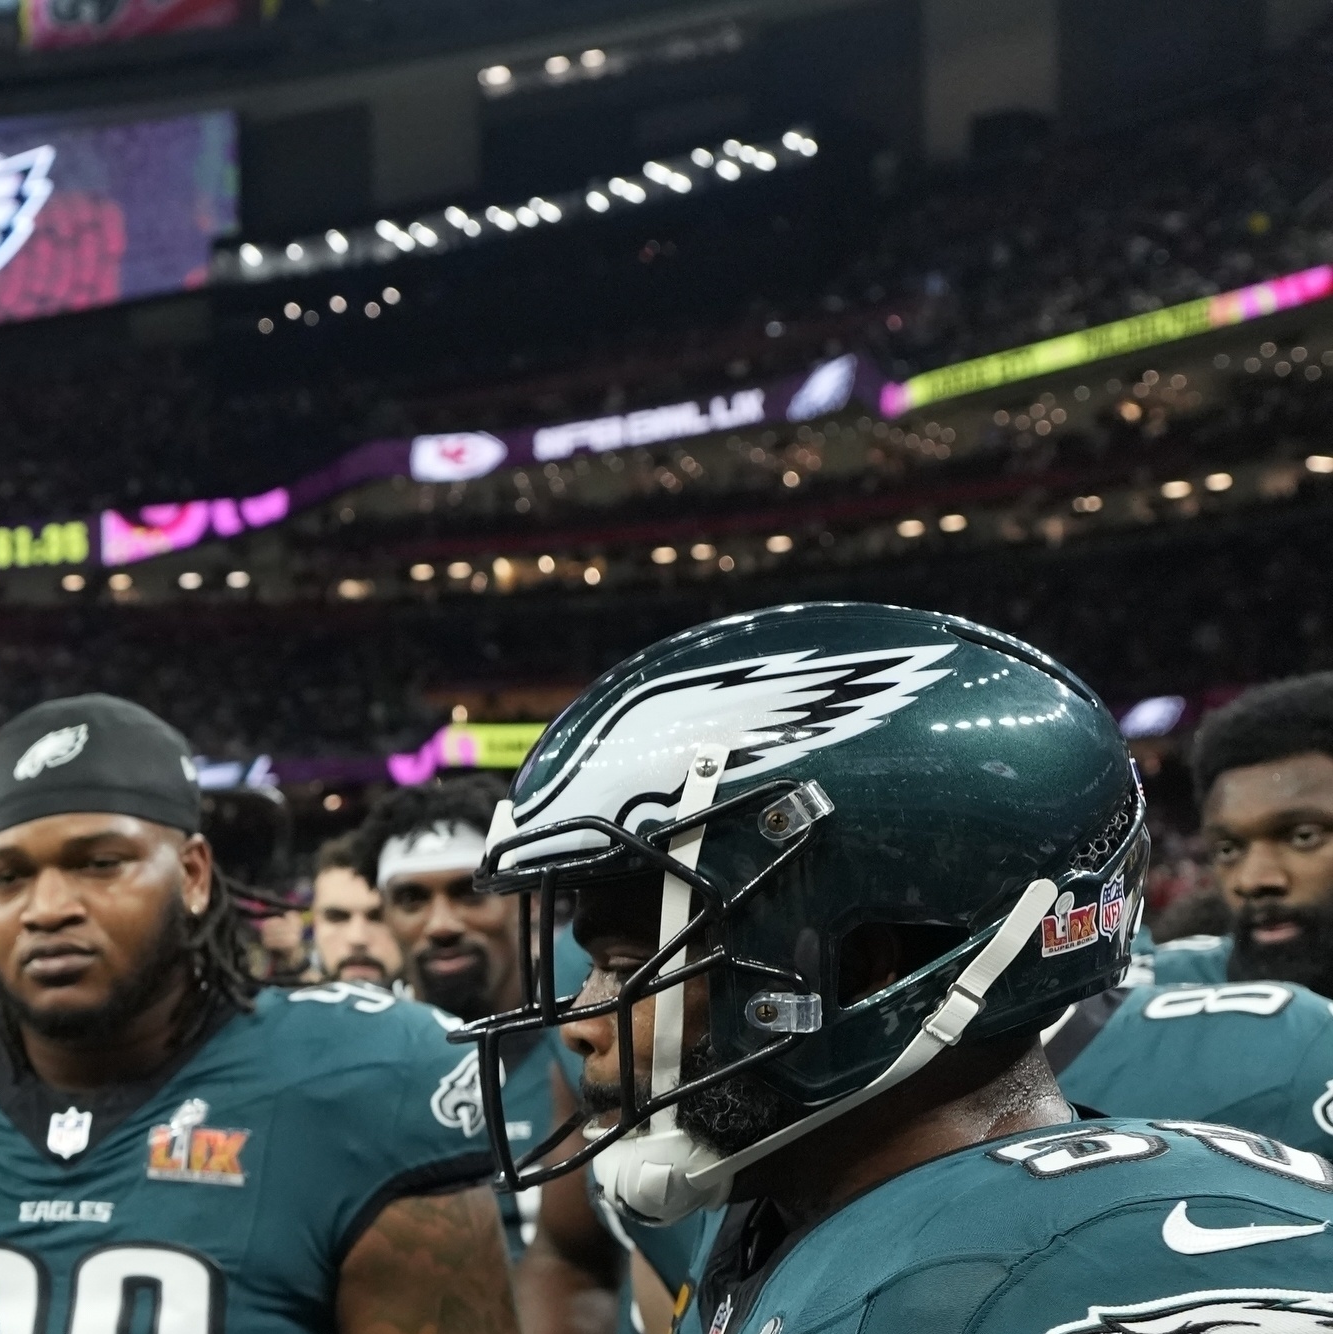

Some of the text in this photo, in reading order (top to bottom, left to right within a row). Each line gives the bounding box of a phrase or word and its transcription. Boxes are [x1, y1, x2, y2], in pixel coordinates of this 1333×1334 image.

[1042, 902, 1098, 948] LIX
[1104, 900, 1122, 929] NFL
[19, 1200, 115, 1224] EAGLES
